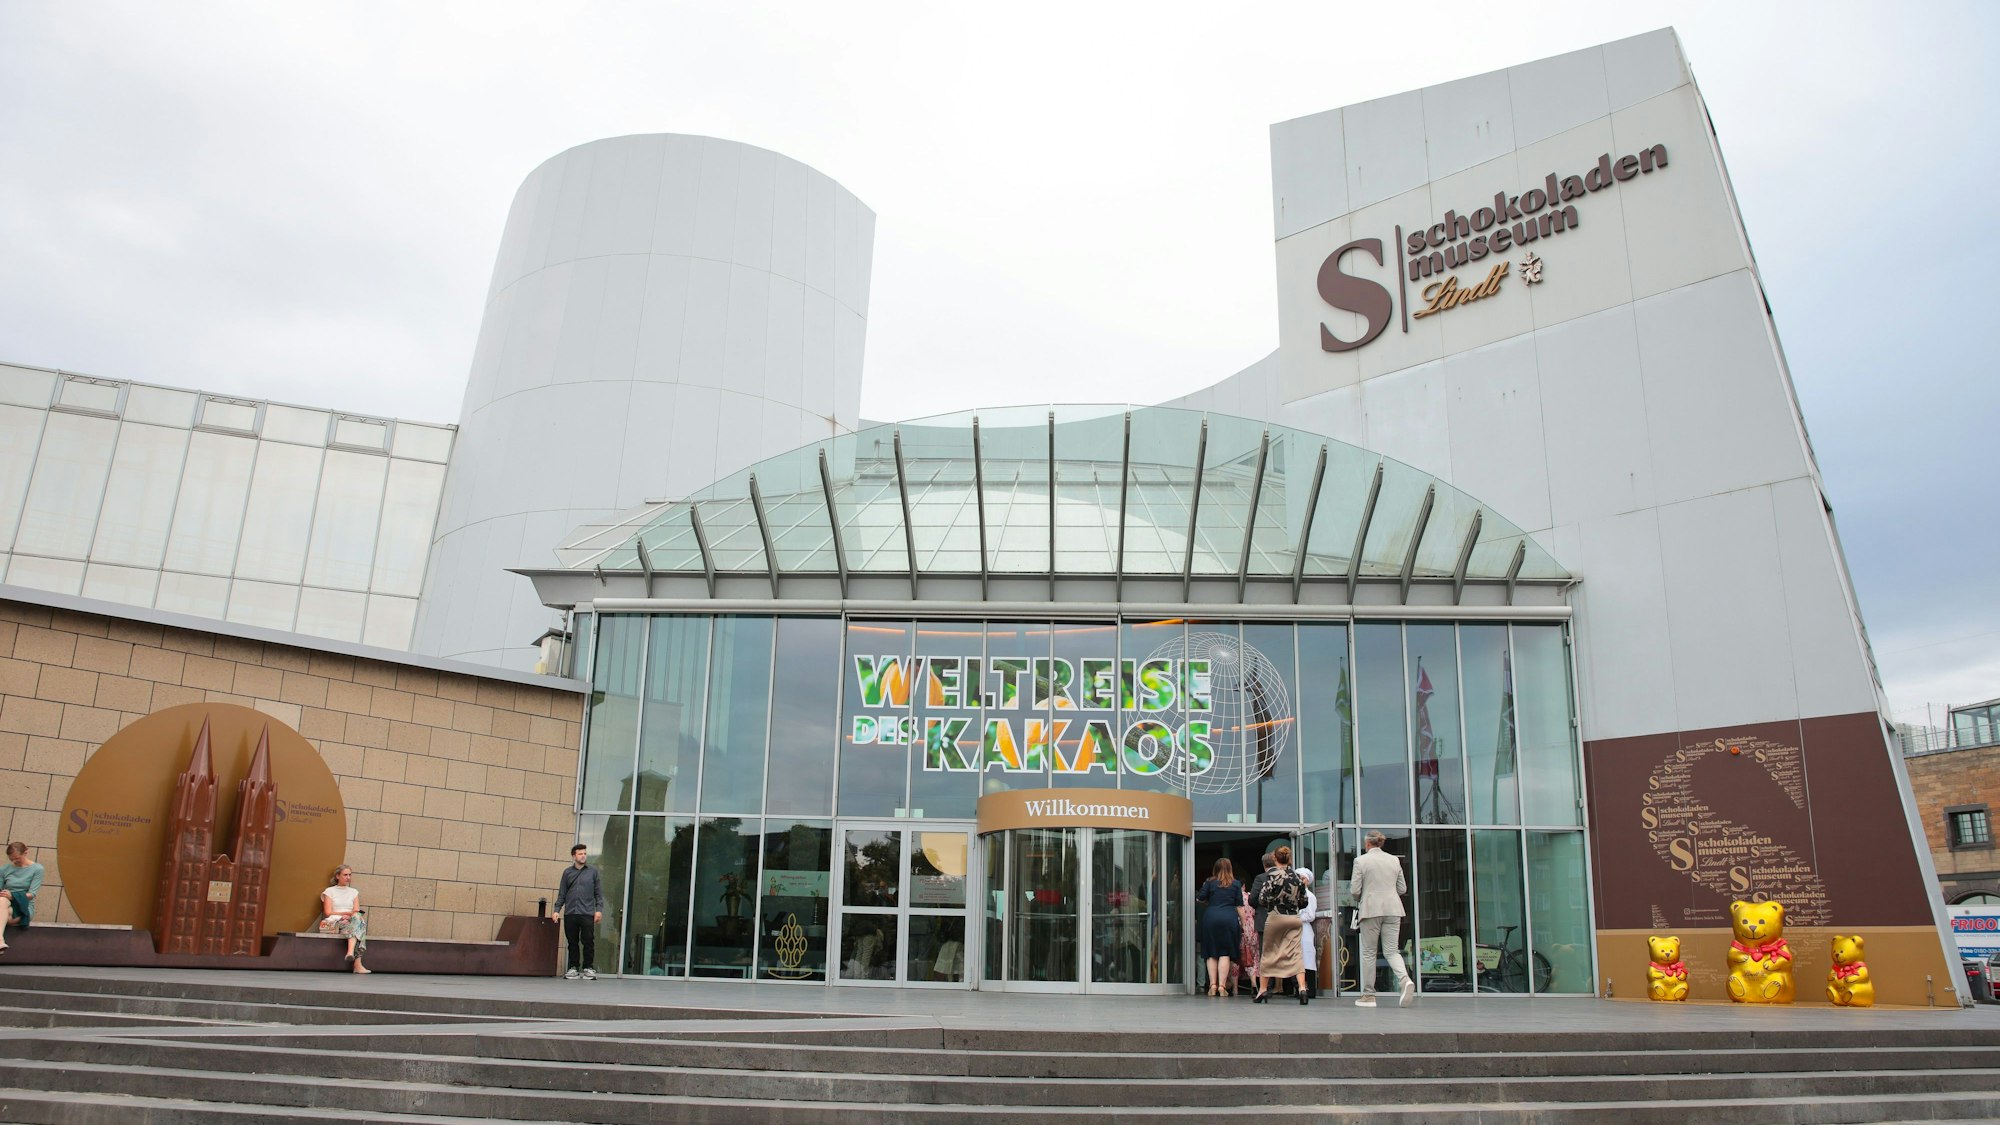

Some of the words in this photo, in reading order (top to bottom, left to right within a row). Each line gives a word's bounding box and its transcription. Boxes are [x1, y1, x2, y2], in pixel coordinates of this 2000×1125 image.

[1407, 143, 1668, 254] schokoladen
[1408, 204, 1579, 282] museum
[1317, 237, 1392, 352] S
[1412, 261, 1510, 319] Lindt
[853, 654, 1213, 713] WELTREISE
[851, 716, 919, 745] DES
[923, 717, 1215, 777] KAKAOS
[1715, 738, 1726, 752] S
[1676, 750, 1685, 762] S
[1755, 748, 1766, 763] S
[1649, 776, 1660, 790] S
[1642, 792, 1652, 805] S
[1025, 799, 1150, 818] Willkommen
[1660, 805, 1709, 813] schokoladen
[67, 808, 89, 833] S
[94, 812, 151, 824] schokoladen
[1641, 807, 1658, 829] S
[1688, 821, 1699, 835] S
[1648, 831, 1658, 843] S
[1698, 836, 1772, 847] schokoladen
[1669, 838, 1694, 871] S
[1698, 846, 1748, 855] museum
[1751, 846, 1760, 858] S
[1691, 870, 1700, 882] S
[1752, 865, 1810, 874] schokoladen
[1730, 866, 1749, 892] S
[1785, 915, 1794, 926] S
[1951, 918, 2000, 930] FRIGO
